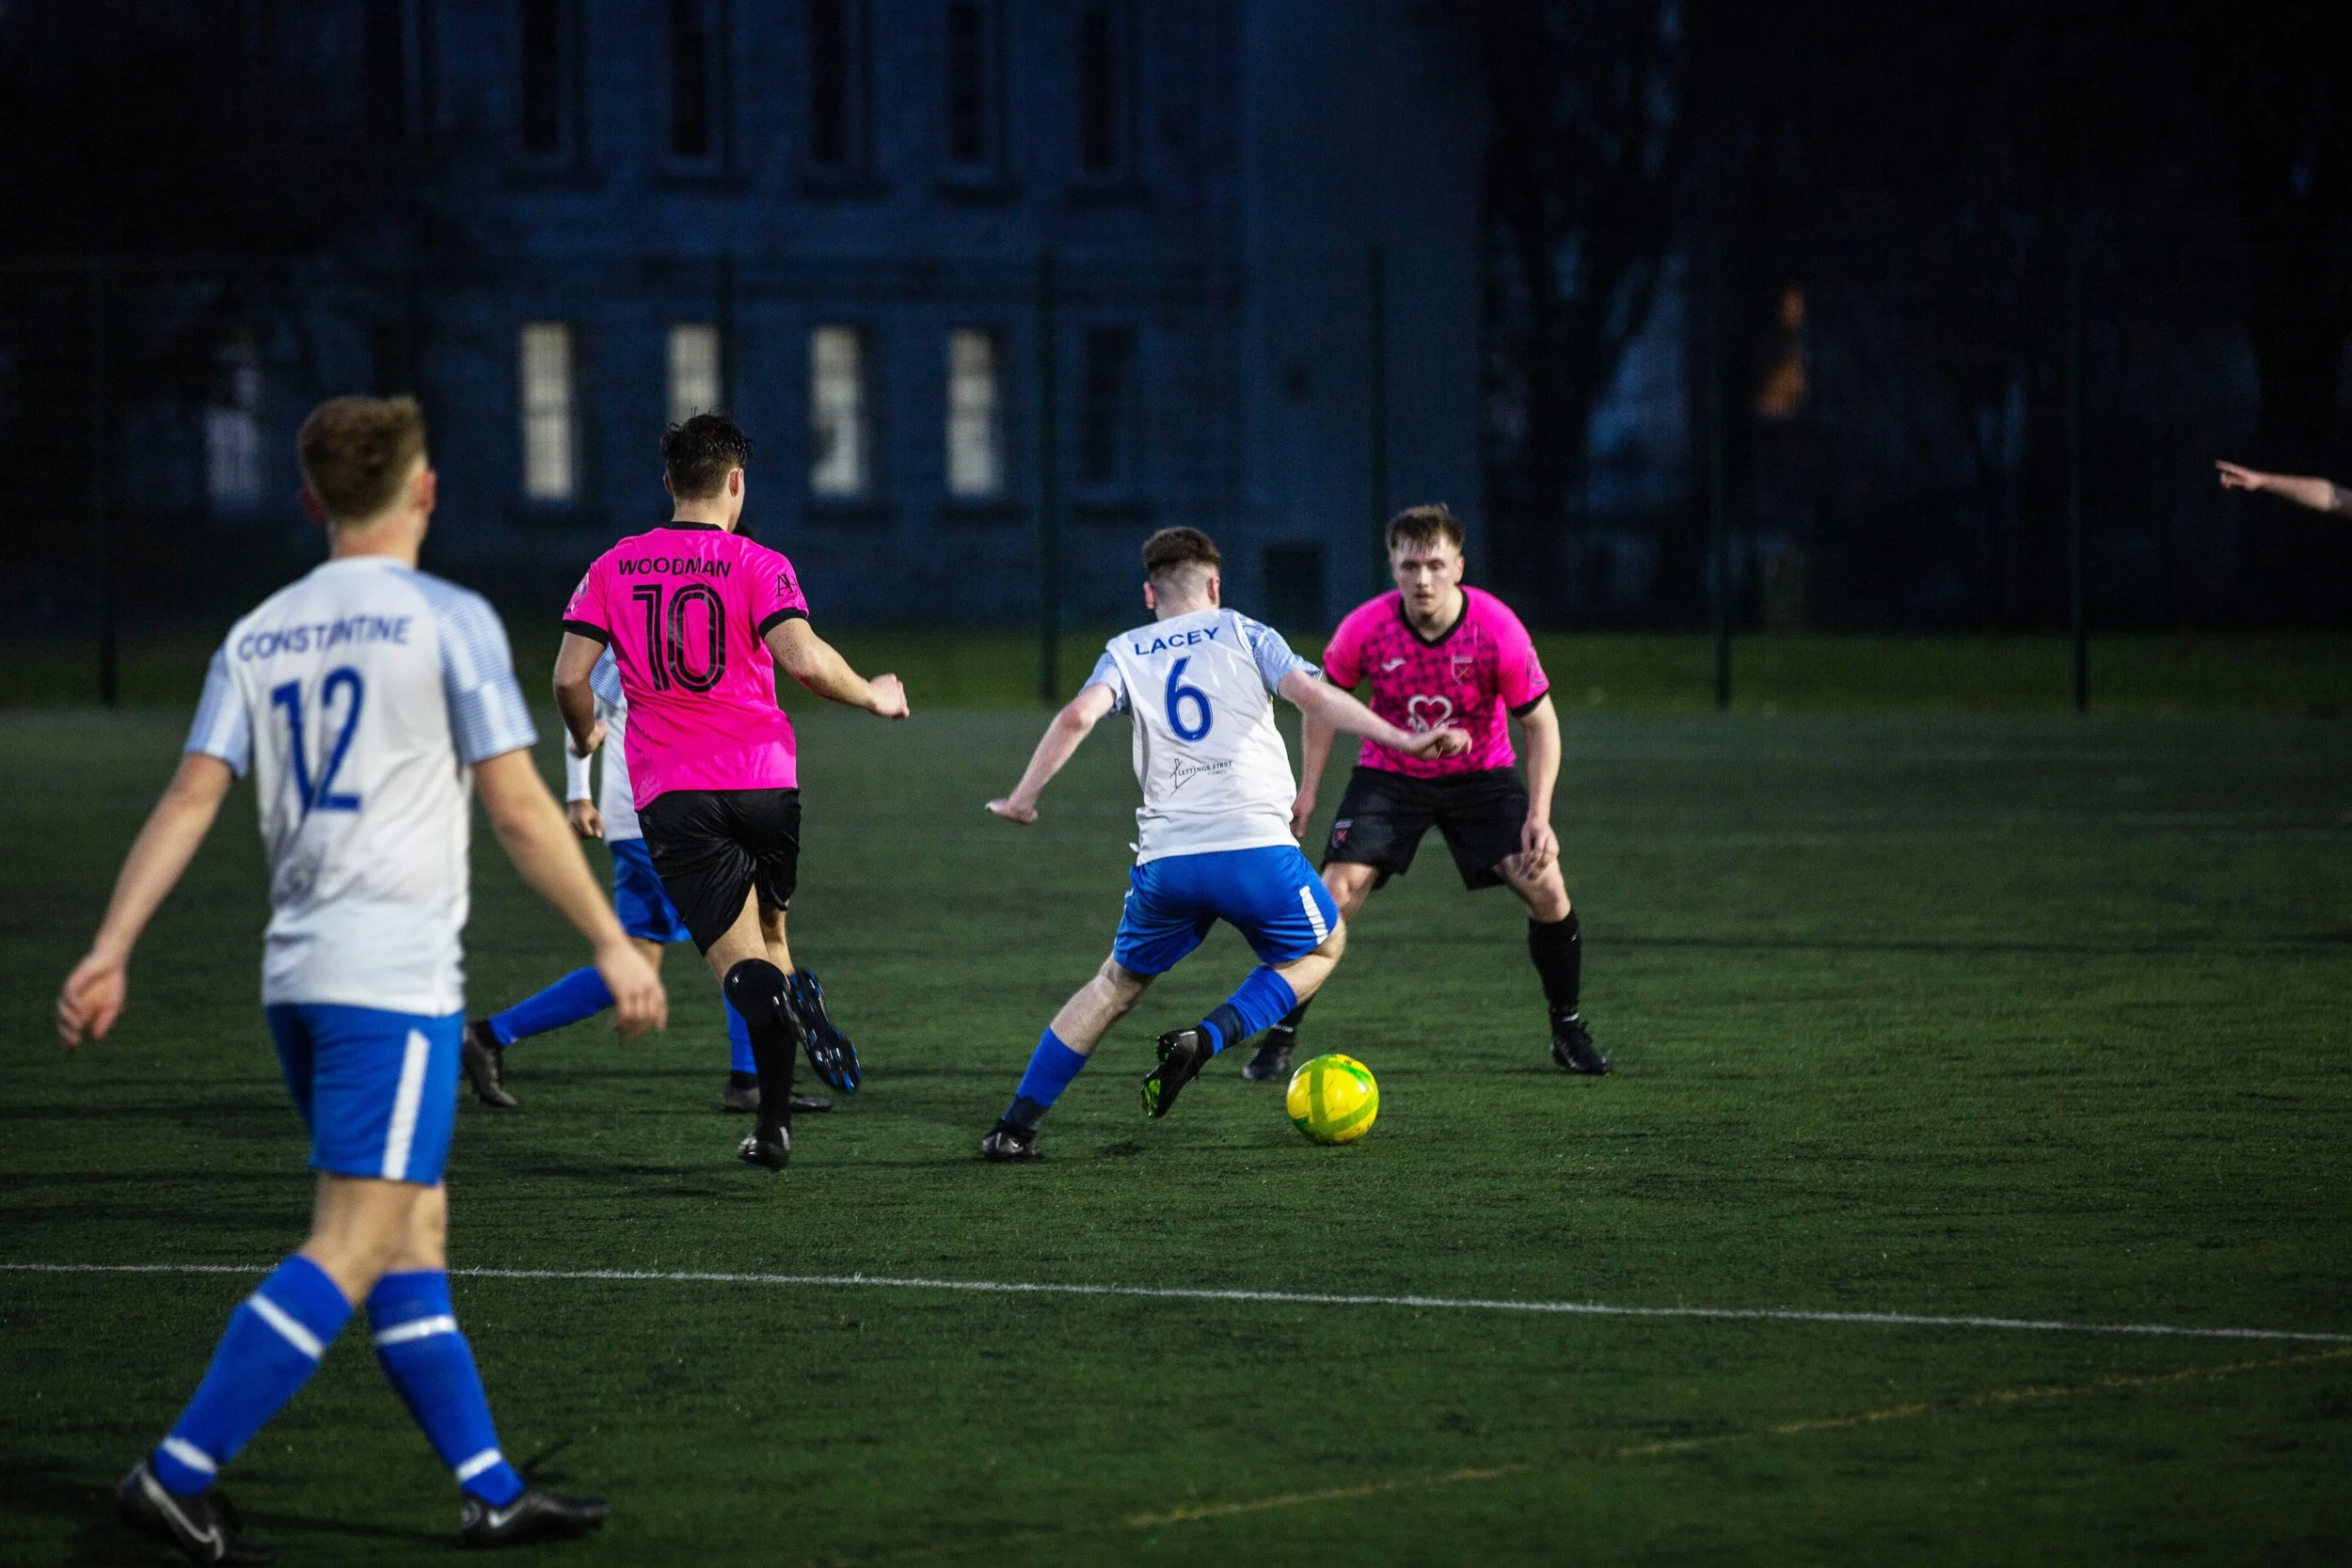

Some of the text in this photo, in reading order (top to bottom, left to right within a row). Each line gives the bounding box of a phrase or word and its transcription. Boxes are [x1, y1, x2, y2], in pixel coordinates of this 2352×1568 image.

[618, 557, 731, 578] WOODMAN
[237, 615, 413, 661] CONSTANTINE
[632, 583, 725, 692] 10
[1135, 626, 1218, 656] LACEY
[1165, 656, 1213, 743] 6
[272, 665, 364, 815] 12
[1178, 766, 1211, 776] LETTINGS
[1213, 760, 1232, 769] FIRST
